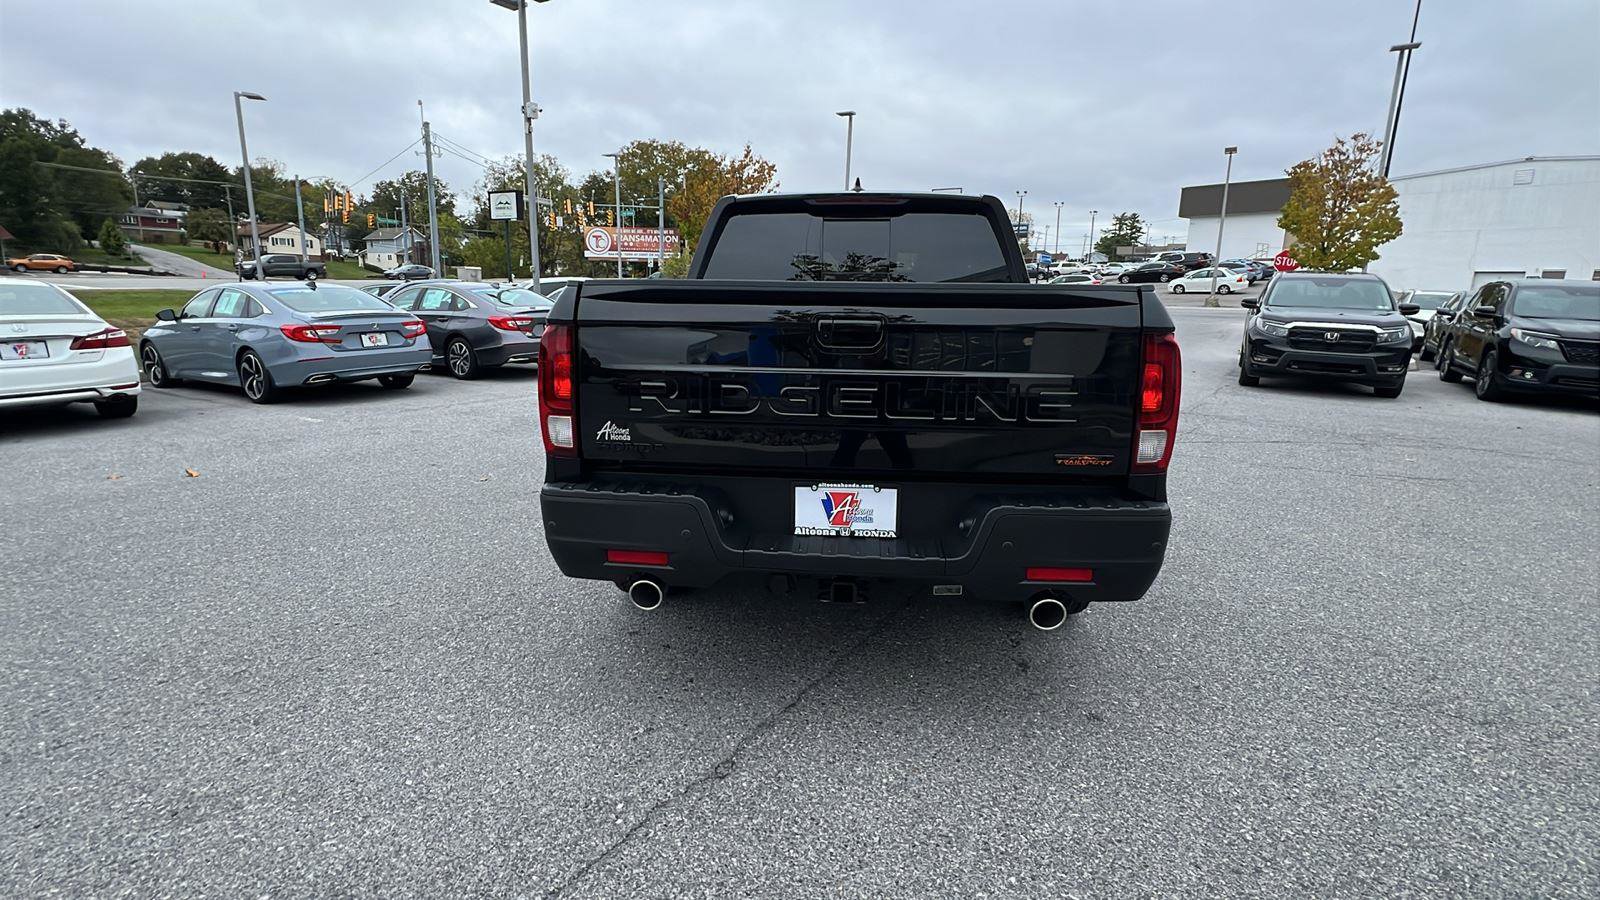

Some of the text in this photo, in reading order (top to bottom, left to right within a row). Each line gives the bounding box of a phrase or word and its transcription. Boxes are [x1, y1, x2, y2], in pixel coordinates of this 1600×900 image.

[628, 379, 1079, 423] RIDGELINE
[794, 527, 897, 538] Altoona HONDA
